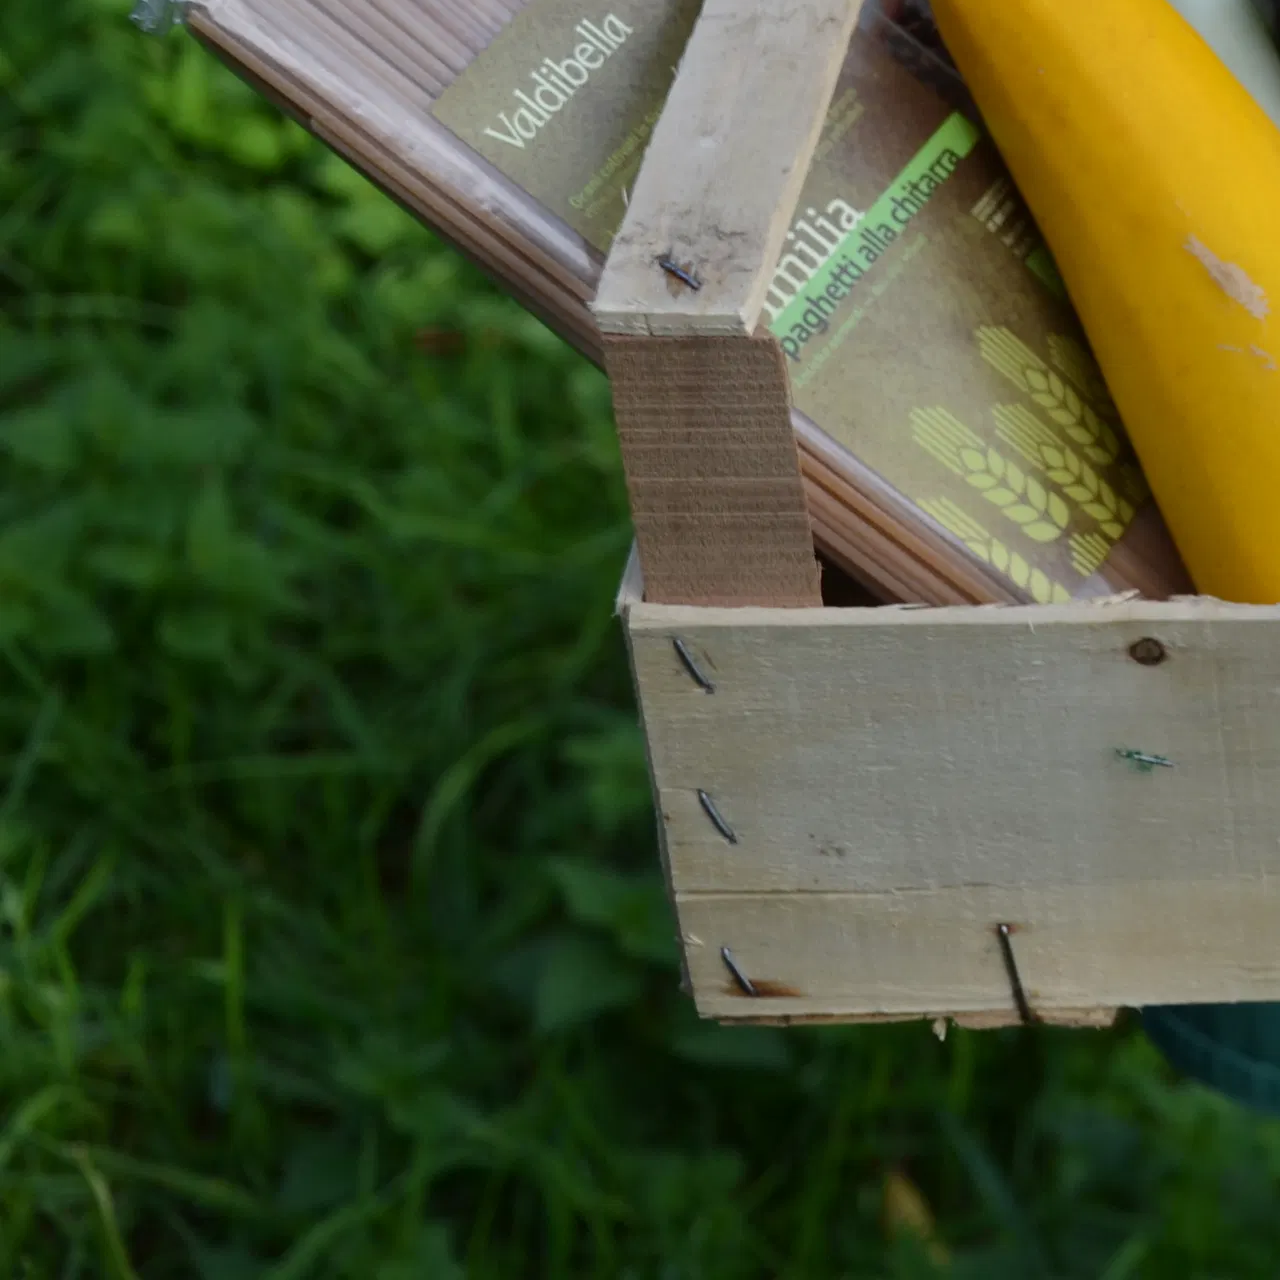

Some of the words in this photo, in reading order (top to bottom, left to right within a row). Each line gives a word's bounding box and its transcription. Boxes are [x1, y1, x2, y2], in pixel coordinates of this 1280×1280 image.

[483, 10, 634, 152] Valdibella
[778, 257, 864, 363] paghetti
[856, 214, 899, 265] alla
[889, 147, 961, 232] chitarra
